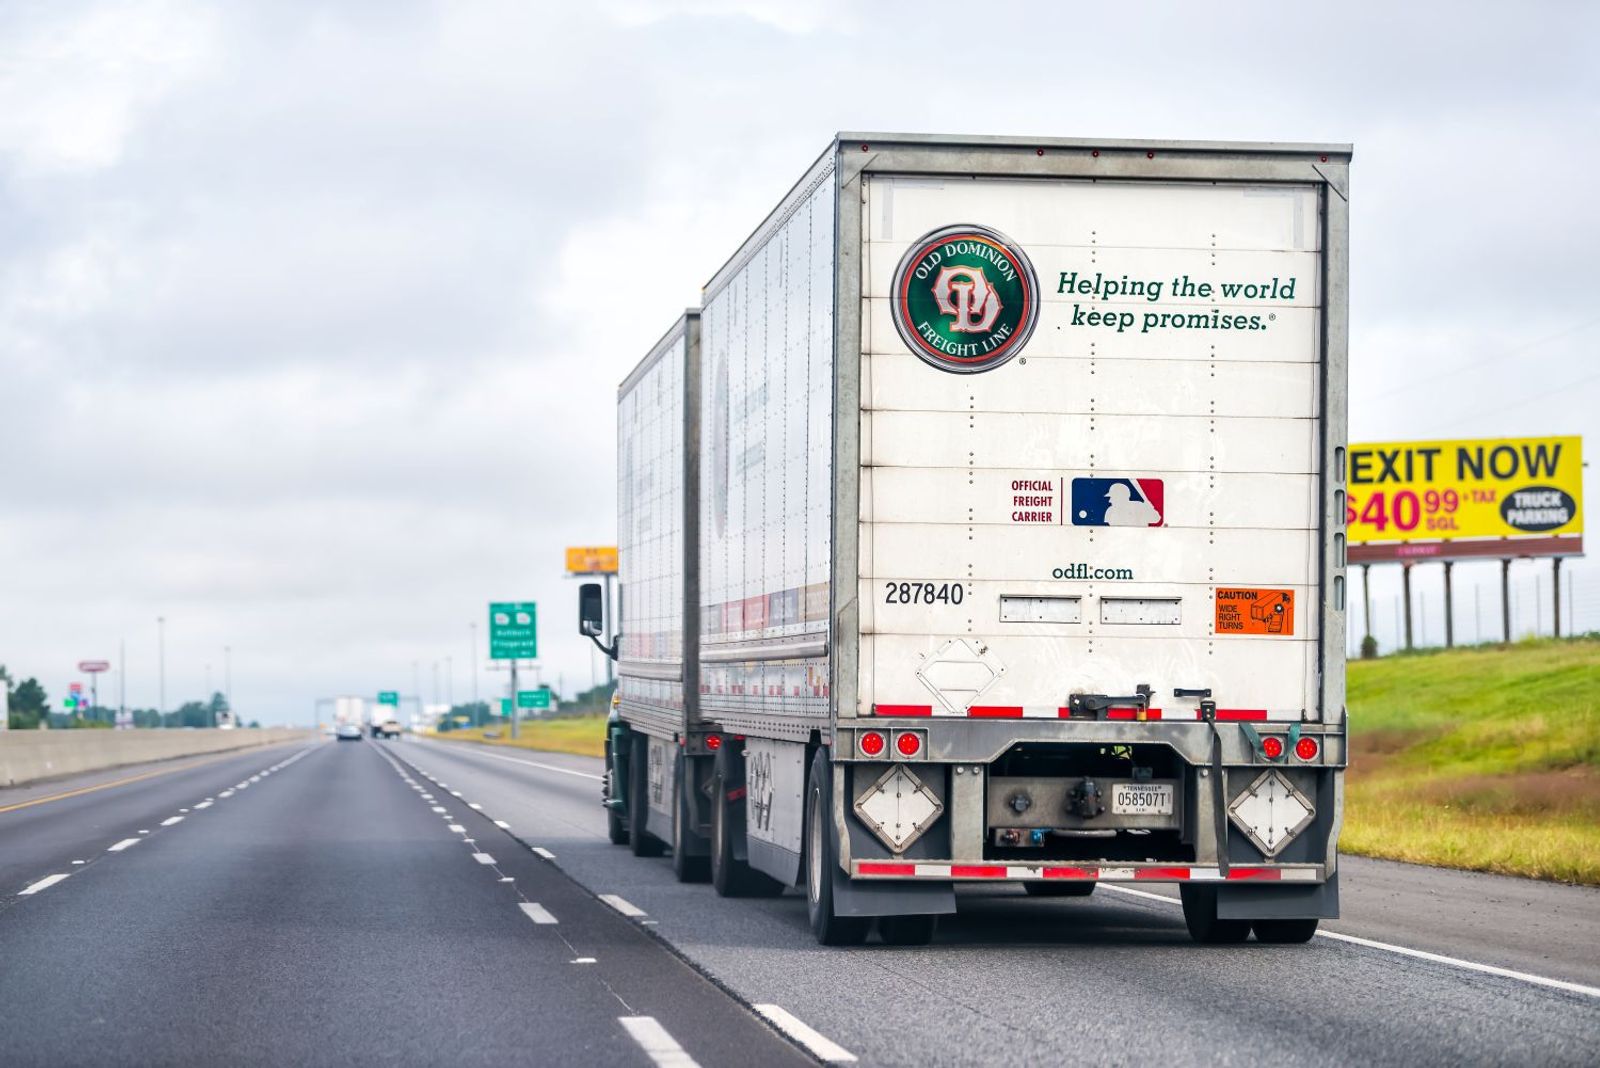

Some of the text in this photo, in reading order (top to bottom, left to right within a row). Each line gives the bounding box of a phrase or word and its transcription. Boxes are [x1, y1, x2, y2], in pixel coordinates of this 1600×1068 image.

[915, 242, 1017, 282] OLD DOMINION
[1057, 272, 1296, 301] Helping the world
[1071, 304, 1134, 333] keep
[917, 321, 1013, 356] FREIGHT LINE
[1350, 444, 1562, 484] EXIT NOW
[1011, 480, 1053, 491] OFFICIAL
[1013, 496, 1053, 507] FREIGHT
[1513, 491, 1562, 508] TRUCK
[1012, 511, 1053, 522] CARRIER
[1507, 508, 1569, 525] PARKING
[1052, 563, 1133, 580] odfl.com
[885, 582, 964, 605] 287840
[1217, 591, 1258, 600] CAUTION
[1218, 604, 1238, 612] WIDE
[1218, 613, 1241, 621] RIGHT
[1218, 622, 1244, 630] TURNS
[1118, 792, 1166, 807] 058507T
